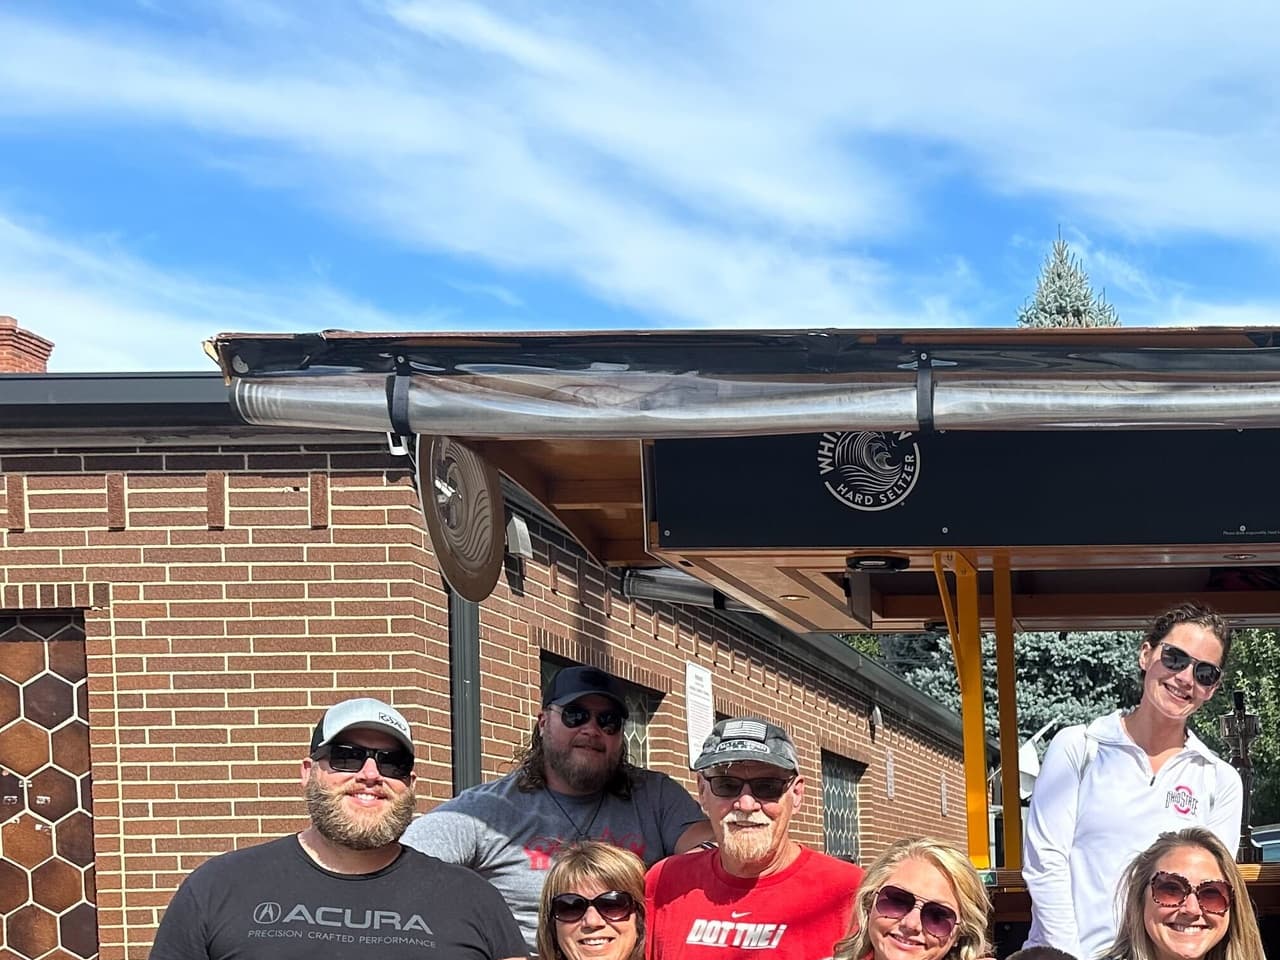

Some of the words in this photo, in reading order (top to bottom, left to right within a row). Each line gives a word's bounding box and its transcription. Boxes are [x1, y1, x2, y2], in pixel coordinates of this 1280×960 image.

[817, 431, 841, 475] WHI
[836, 483, 873, 505] HARD
[880, 454, 915, 504] SELTZER
[282, 903, 434, 935] ACURA
[247, 928, 303, 939] PRECISION
[307, 931, 355, 944] CRAFTED
[359, 935, 437, 949] PERFORMANCE
